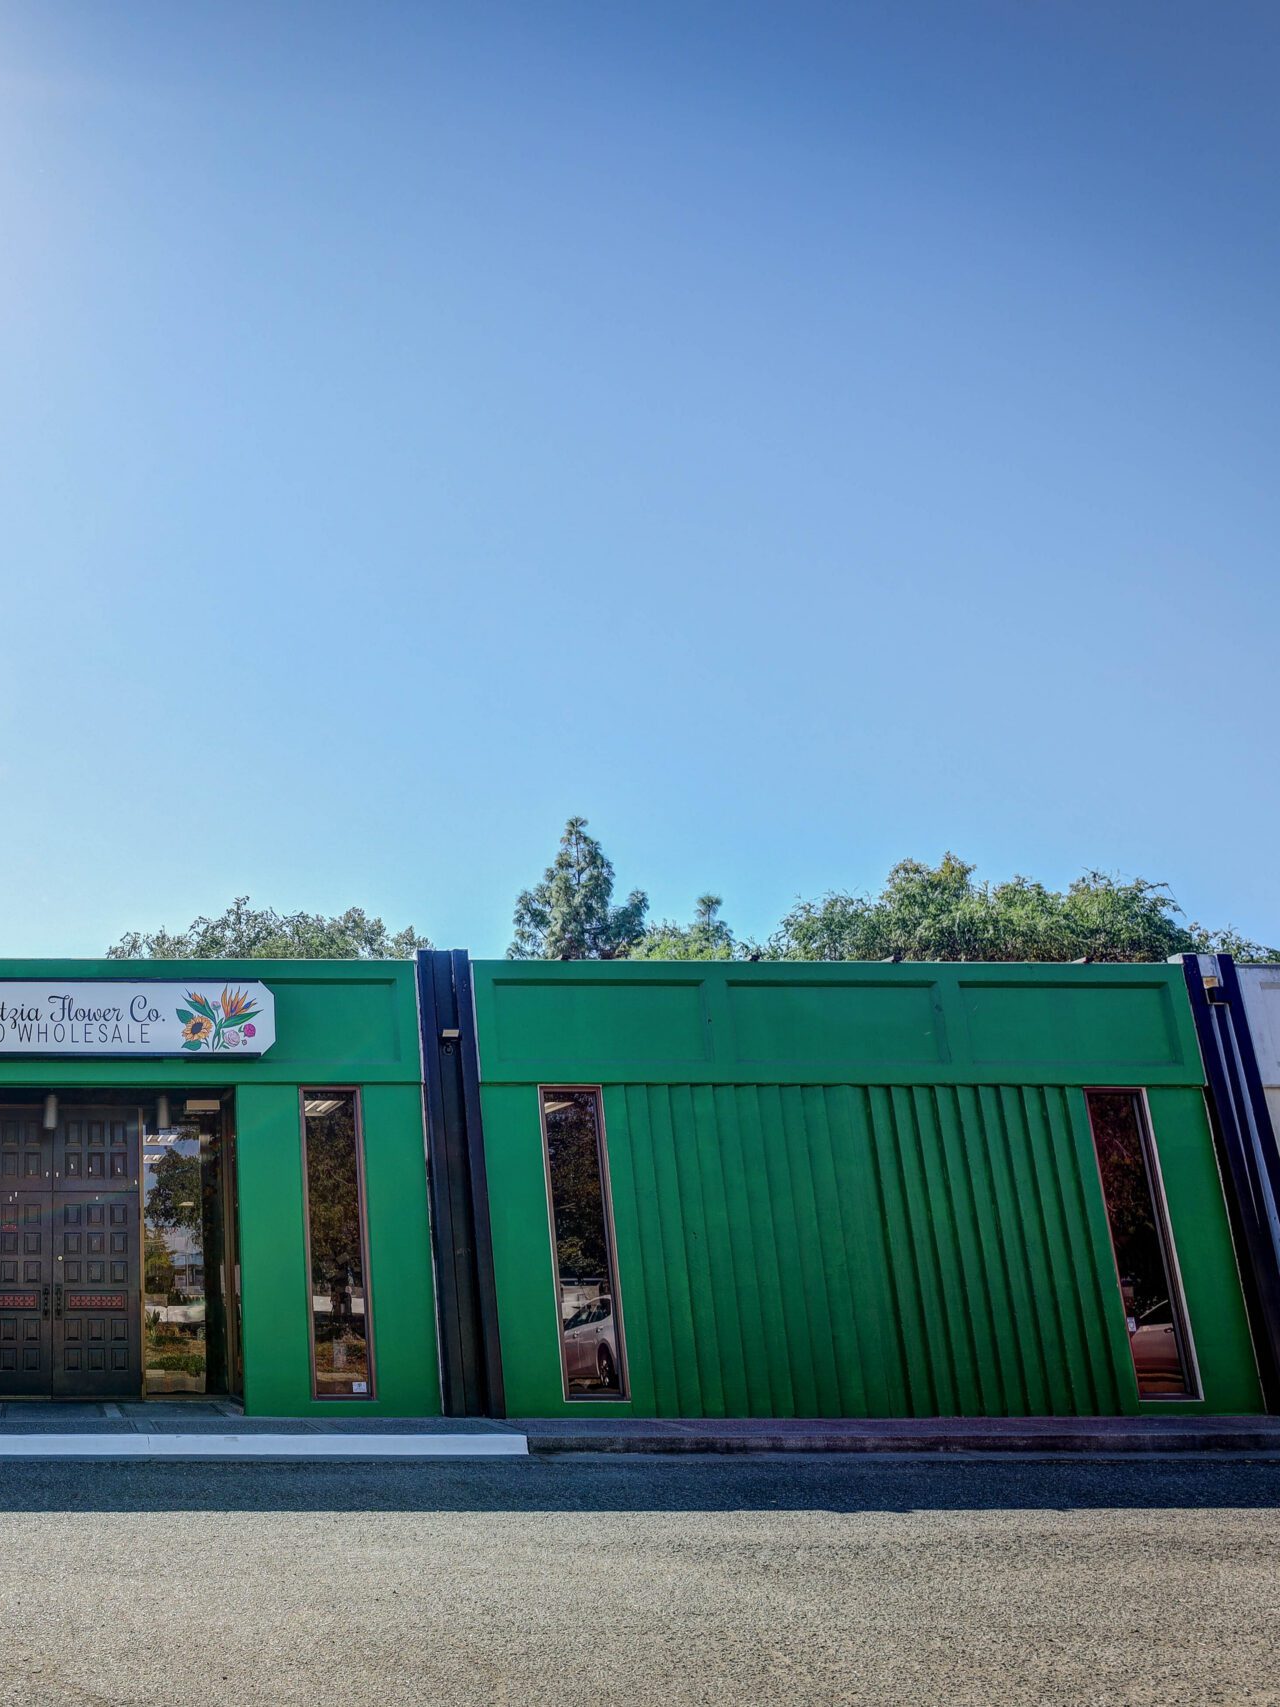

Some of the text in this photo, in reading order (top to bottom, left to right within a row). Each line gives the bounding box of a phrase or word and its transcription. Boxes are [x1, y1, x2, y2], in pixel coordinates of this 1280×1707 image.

[48, 995, 124, 1022] Flower
[130, 995, 166, 1023] Co.
[18, 1023, 151, 1043] WHOLESALE
